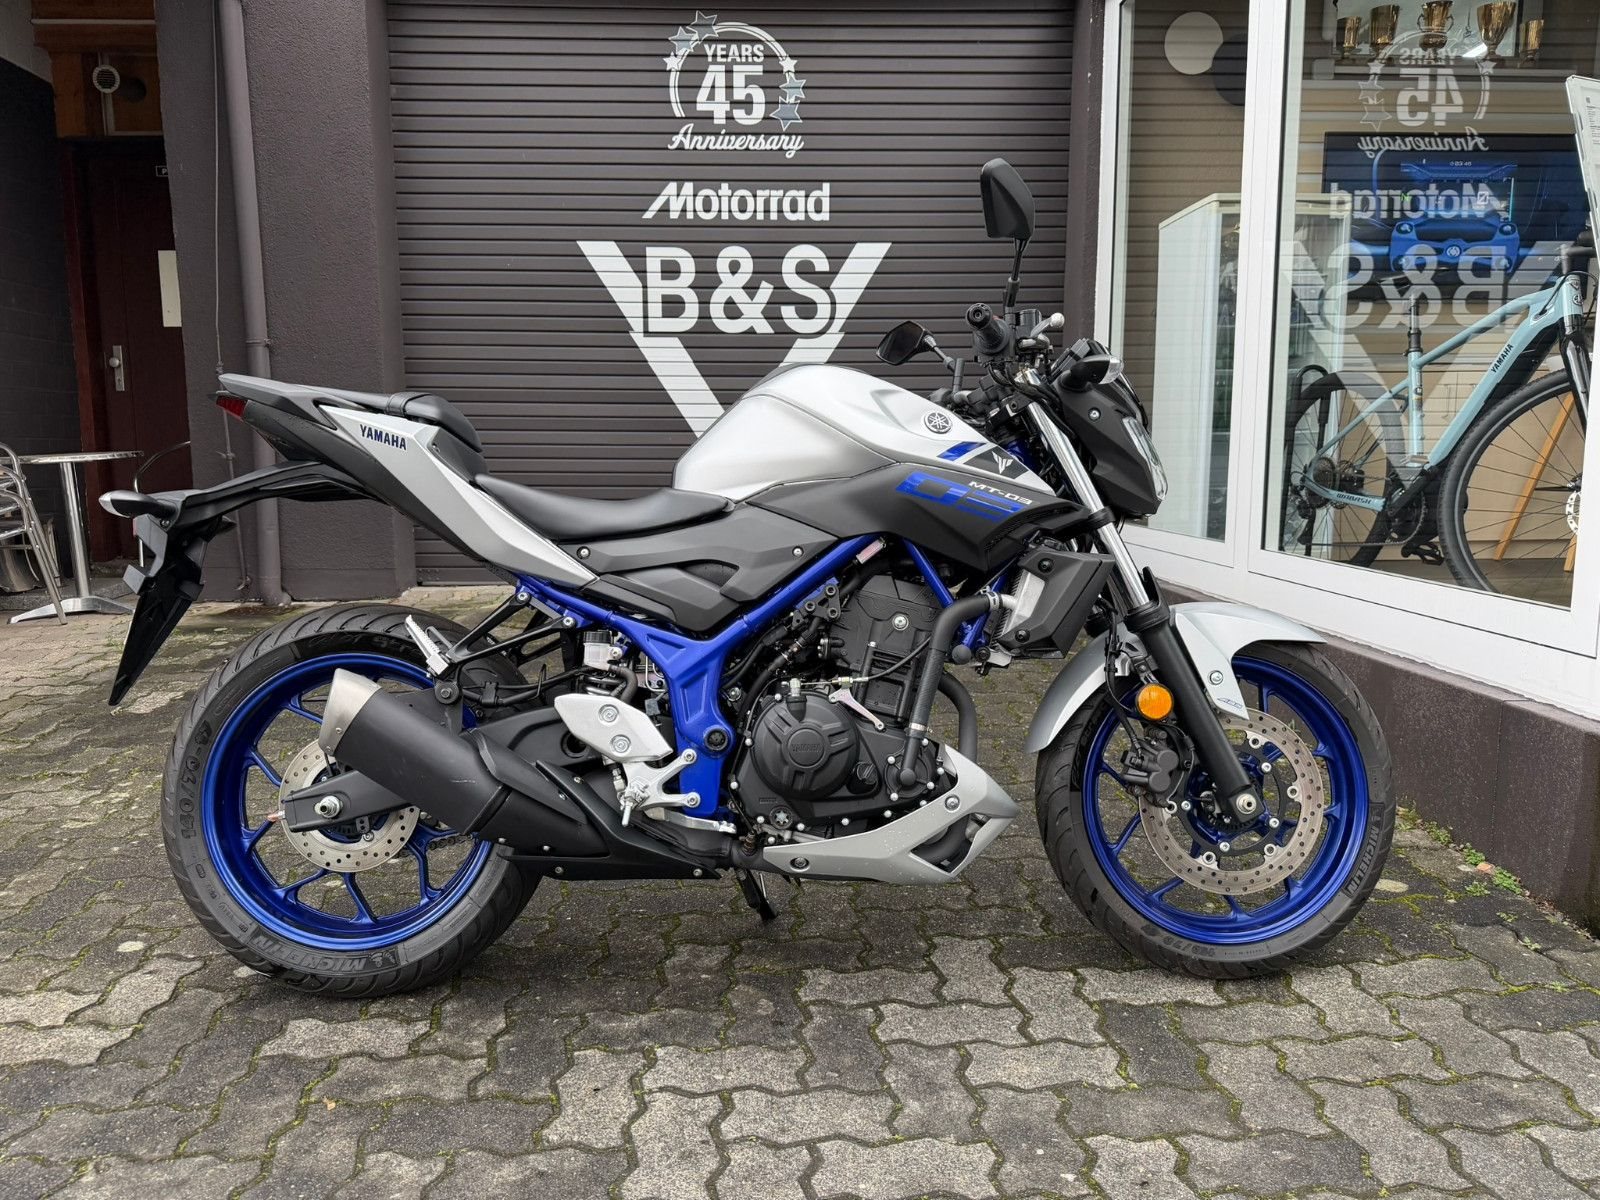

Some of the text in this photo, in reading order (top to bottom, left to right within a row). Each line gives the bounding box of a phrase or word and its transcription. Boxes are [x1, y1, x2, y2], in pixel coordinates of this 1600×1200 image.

[704, 43, 764, 63] YEARS
[696, 64, 765, 126] 45
[668, 123, 804, 158] Anniversary
[641, 181, 830, 221] Motorrad
[645, 243, 832, 334] B&S
[1490, 343, 1514, 373] YAMAHA
[360, 423, 407, 450] YAMAHA
[968, 480, 1033, 505] MT-03
[1346, 825, 1379, 894] MICHELIN
[252, 935, 367, 971] MICHELIN
